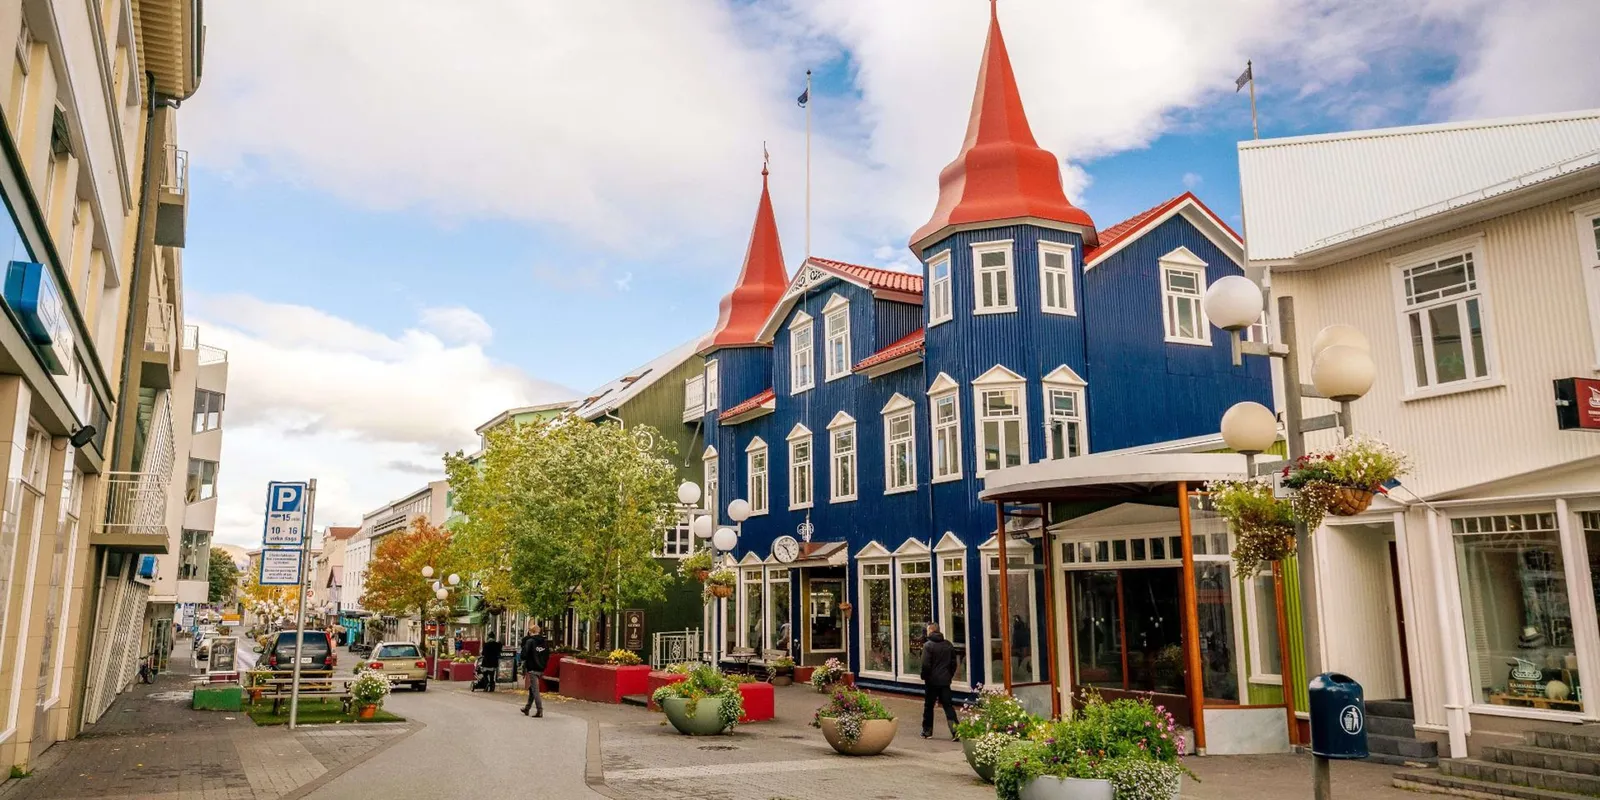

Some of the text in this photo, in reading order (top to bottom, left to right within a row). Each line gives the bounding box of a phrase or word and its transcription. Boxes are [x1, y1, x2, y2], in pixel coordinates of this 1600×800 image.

[278, 488, 296, 509] P
[282, 514, 290, 522] 15
[271, 526, 281, 535] 10
[289, 526, 298, 535] 16
